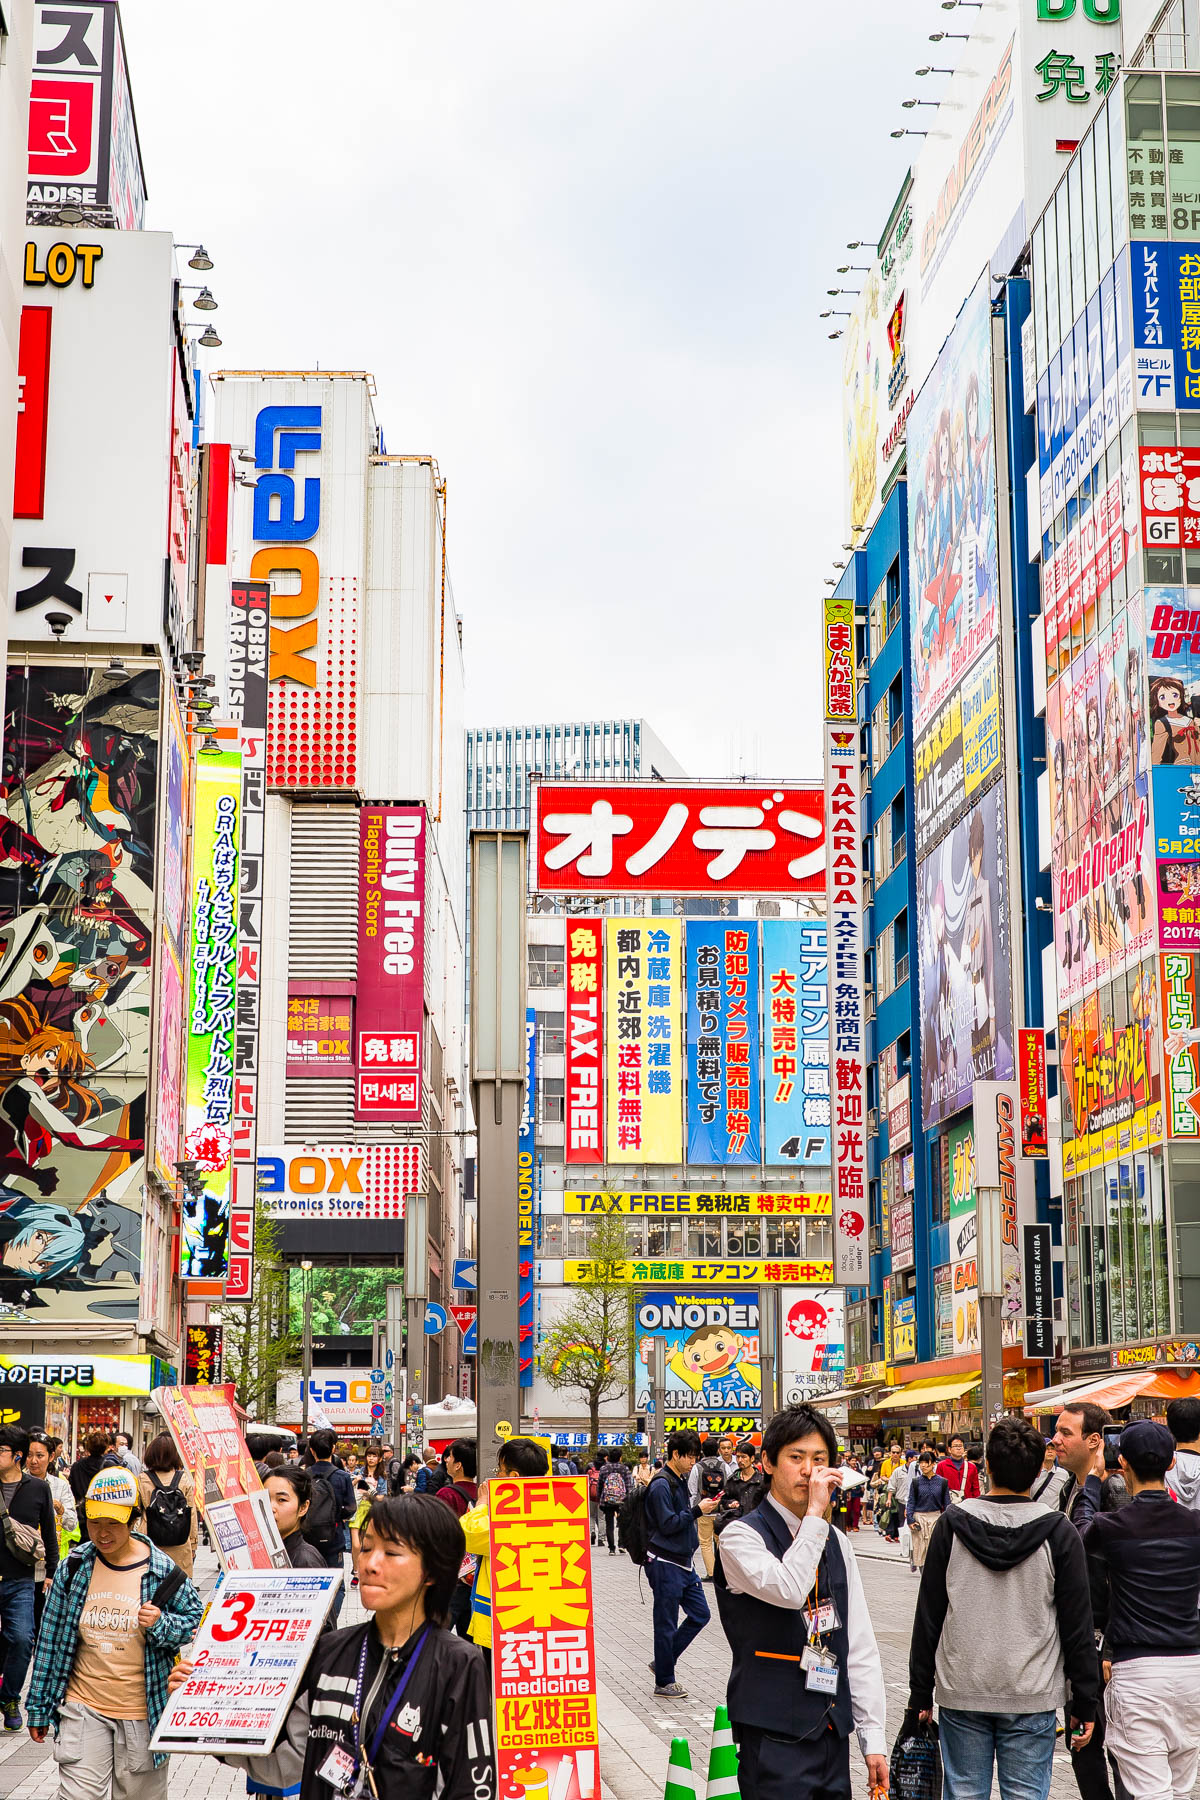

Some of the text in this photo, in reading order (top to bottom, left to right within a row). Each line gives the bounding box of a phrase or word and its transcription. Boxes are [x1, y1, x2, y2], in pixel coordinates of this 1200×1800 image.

[36, 10, 99, 66] ス
[1129, 149, 1184, 164] 不動産
[1129, 170, 1165, 186] 賃貸
[1130, 193, 1165, 207] 売買
[1131, 214, 1167, 230] 管理
[24, 242, 103, 288] LOT
[1144, 246, 1163, 345] レオパレス21
[1137, 358, 1171, 370] 当ビル
[1137, 375, 1171, 397] 7F
[1149, 522, 1176, 539] 6F
[15, 547, 83, 614] ス
[249, 591, 267, 679] HOBBY
[828, 623, 852, 714] まんが喫茶
[543, 792, 826, 880] オノデン
[831, 765, 857, 904] TAKARADA
[364, 815, 382, 937] Flagship Store
[381, 815, 422, 975] Duty Free
[288, 999, 320, 1014] 本店
[834, 982, 860, 1053] 免税商店
[288, 1016, 350, 1031] 総合家電
[570, 928, 598, 1150] 免税 TAX FREE
[696, 946, 721, 1123] お見積り無料です
[770, 969, 796, 1103] 大特売中!!
[287, 1039, 349, 1055] Laox
[364, 1037, 414, 1063] 免税
[979, 1046, 997, 1077] SALE
[1167, 956, 1196, 1136] カードゲム専門店
[362, 1083, 415, 1101] 면세점
[1026, 1042, 1038, 1113] カードキングダム
[1074, 1023, 1150, 1131] カードキングダム
[779, 1137, 826, 1159] 4F
[995, 1093, 1018, 1251] GAMERS
[328, 1198, 364, 1211] Store
[518, 1151, 532, 1247] ONODEN
[576, 1194, 622, 1212] TAX
[630, 1194, 690, 1212] FREE
[696, 1194, 750, 1212] 免税店
[705, 1237, 801, 1255] MODIFY
[577, 1264, 624, 1280] テレビ
[632, 1263, 684, 1280] 冷蔵庫
[692, 1264, 757, 1280] エアコン
[674, 1296, 735, 1305] Welcome to
[1036, 1288, 1044, 1348] ALIENWARE
[495, 1482, 550, 1515] 2F
[494, 1522, 590, 1631] 薬
[500, 1630, 589, 1678] 药品
[183, 1681, 286, 1697] 全額キャッシュバック
[502, 1678, 590, 1696] medicine
[501, 1729, 595, 1746] cosmetics
